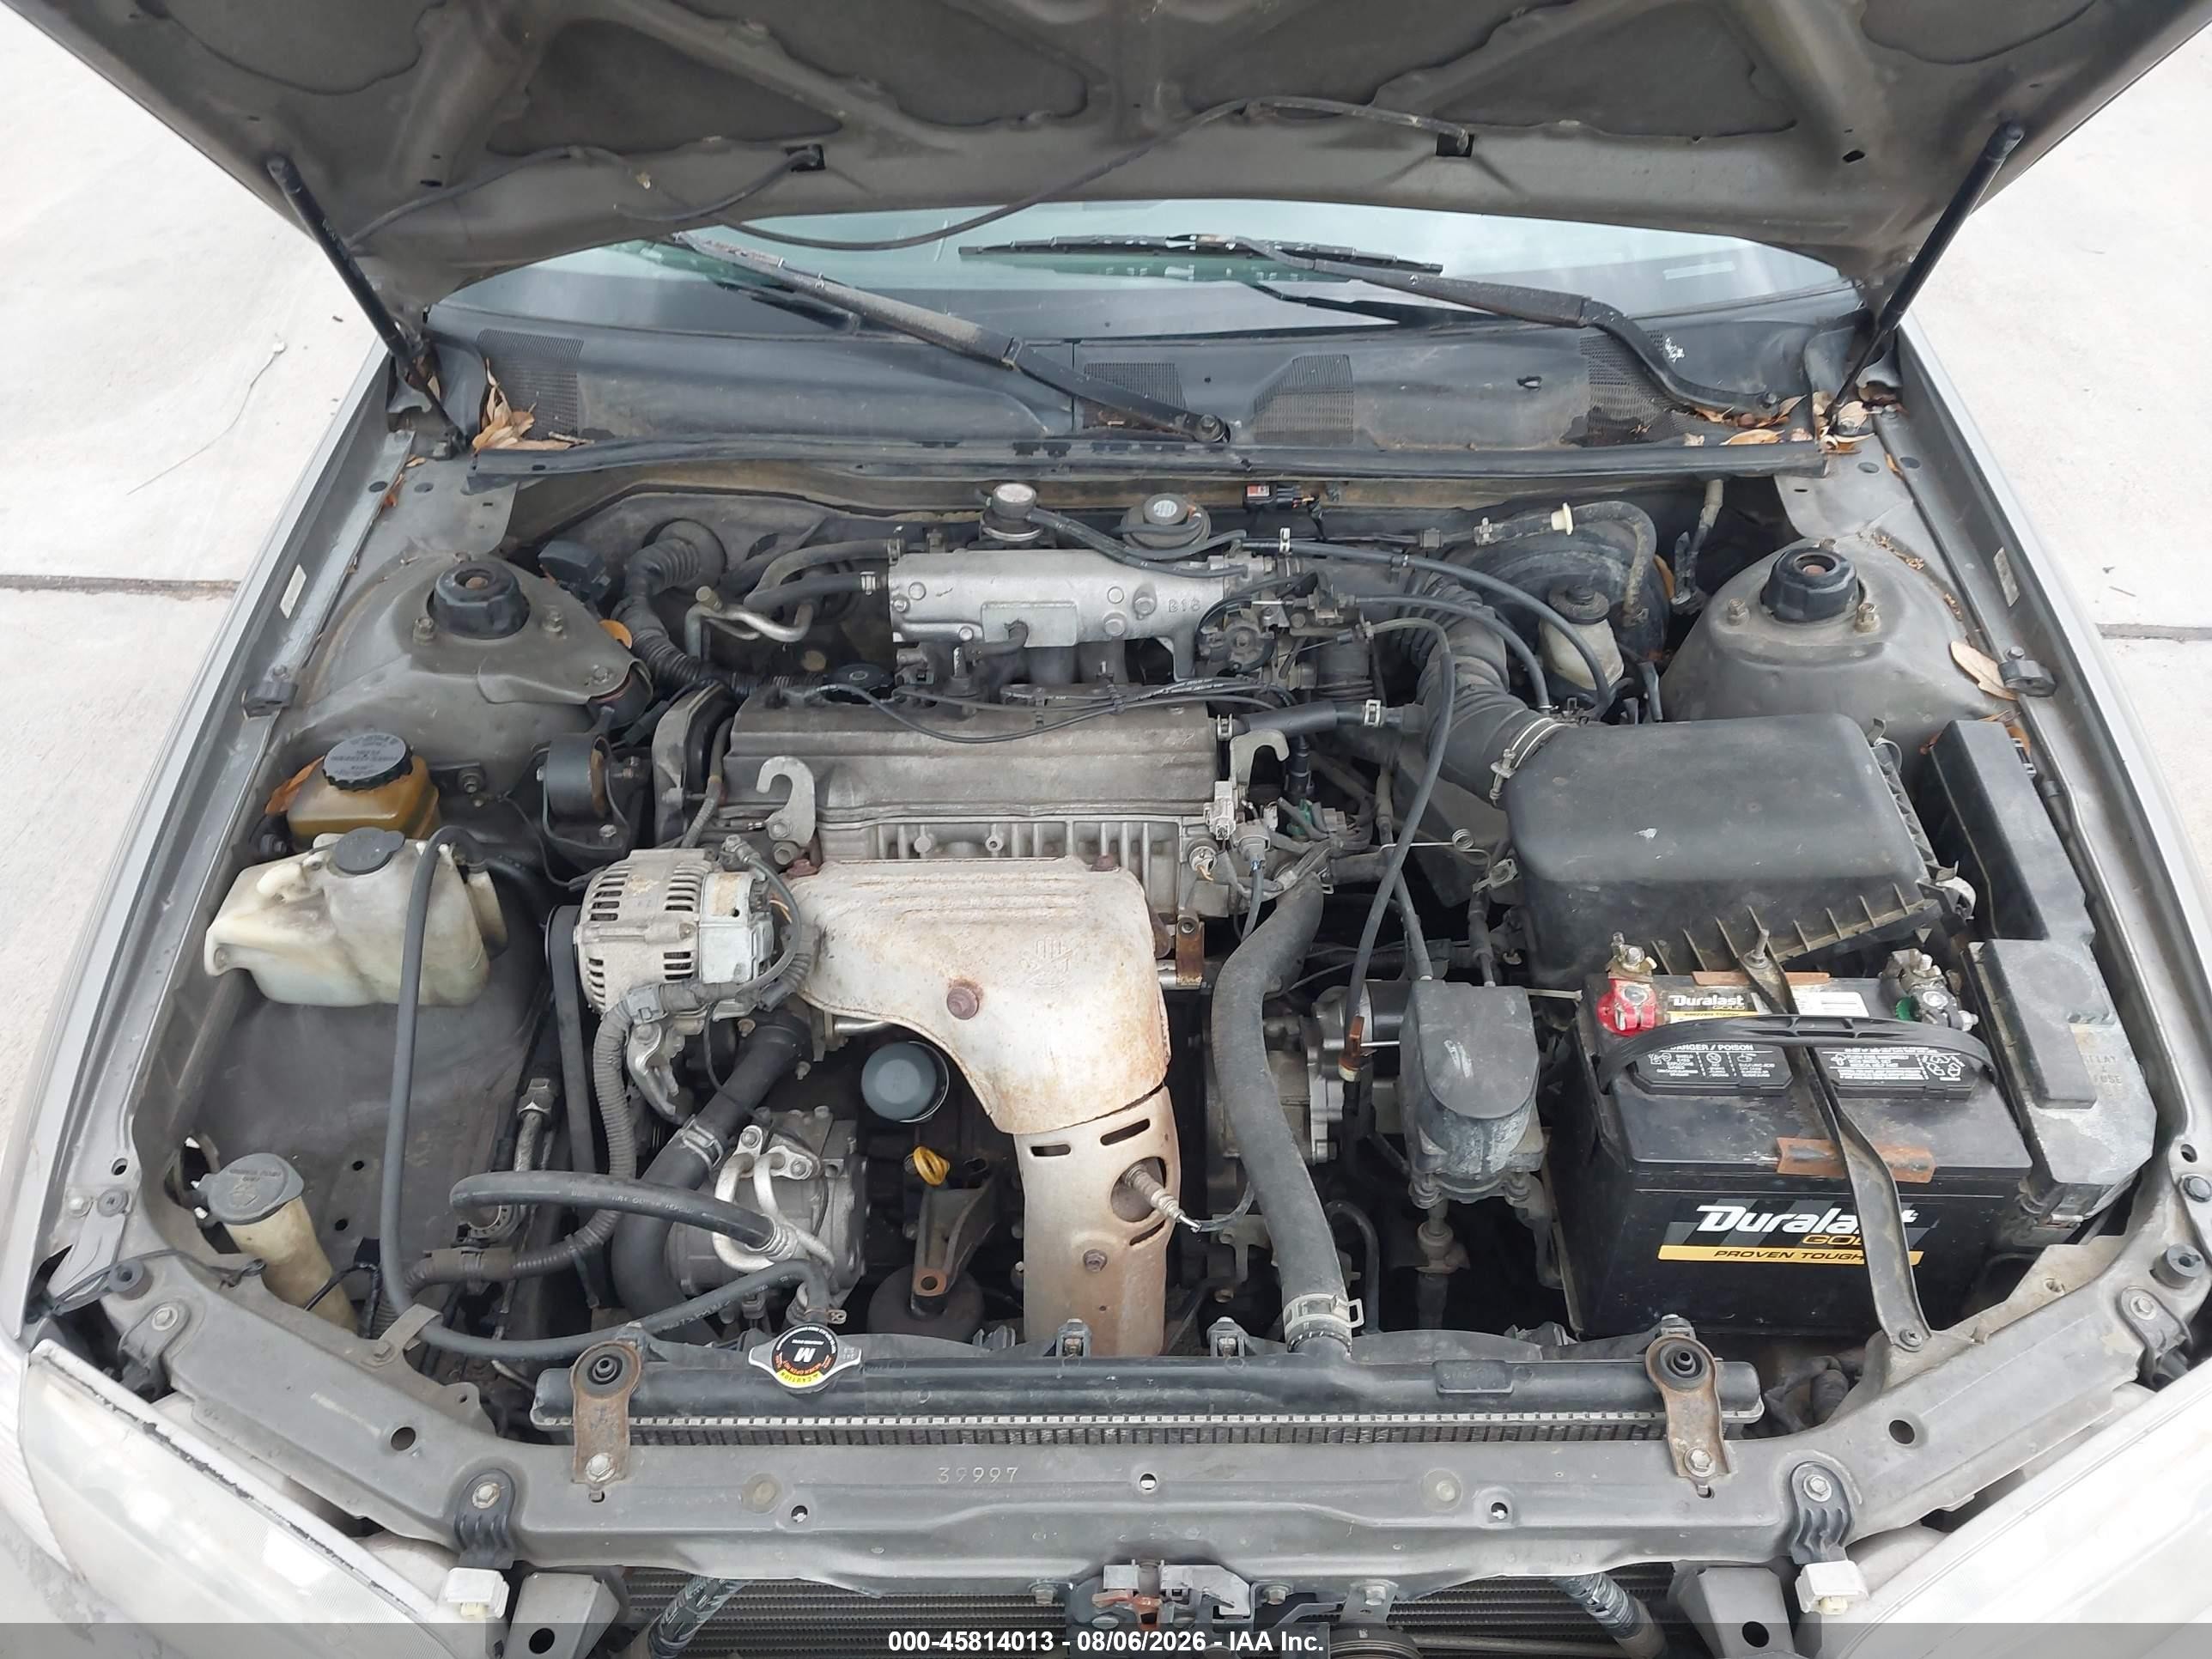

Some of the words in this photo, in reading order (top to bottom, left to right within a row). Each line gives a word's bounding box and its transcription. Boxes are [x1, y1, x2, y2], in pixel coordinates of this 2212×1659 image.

[1668, 994, 1745, 1006] Duralast
[793, 1347, 817, 1363] M
[781, 1371, 812, 1383] CAUTION
[936, 1467, 1018, 1484] 39997
